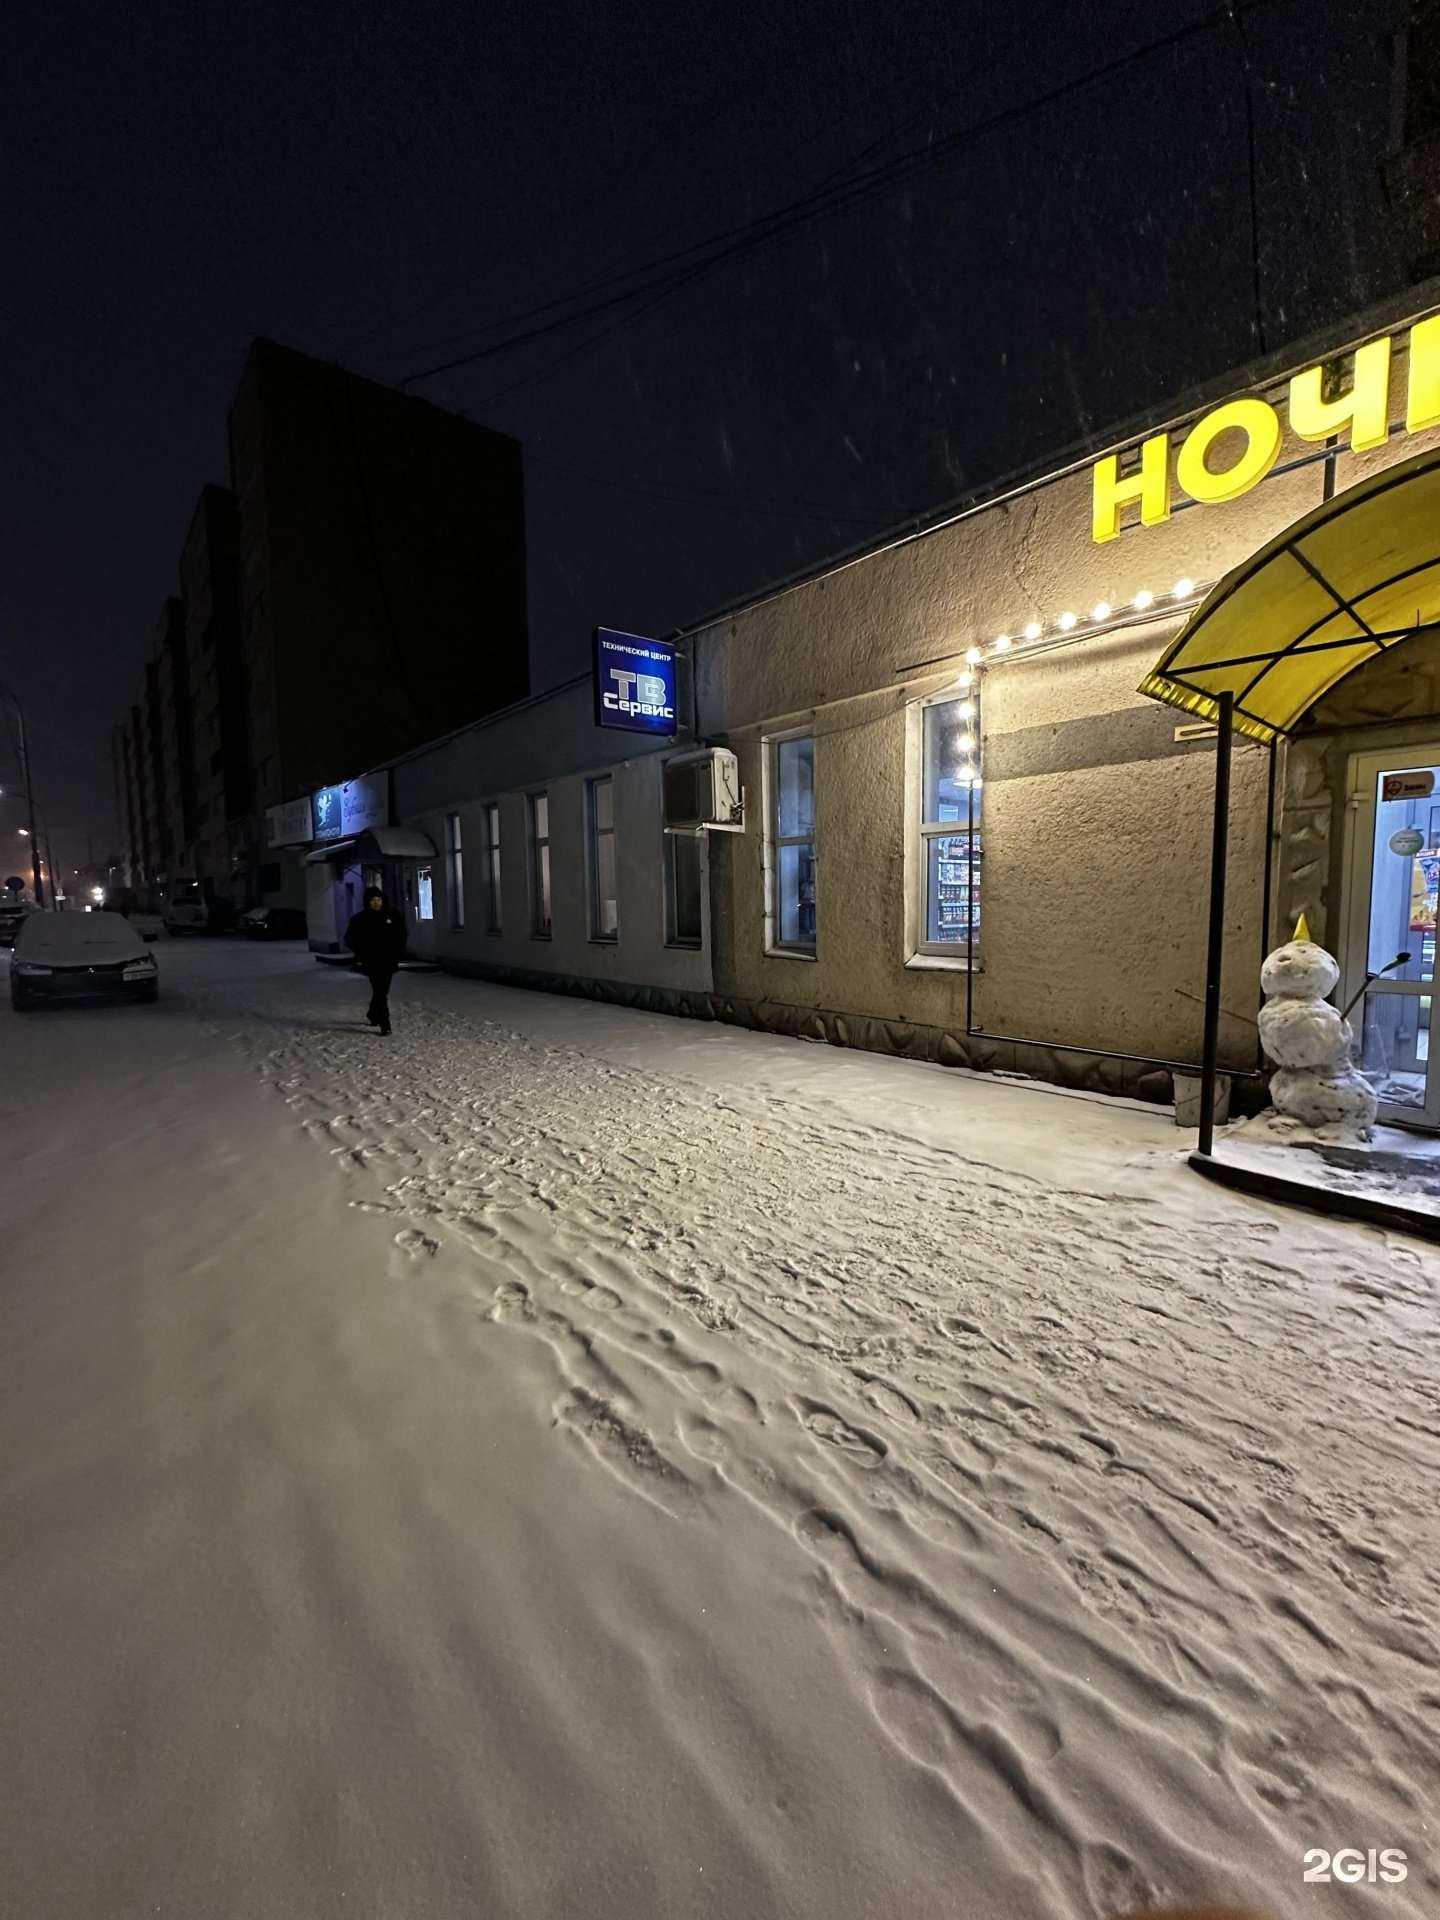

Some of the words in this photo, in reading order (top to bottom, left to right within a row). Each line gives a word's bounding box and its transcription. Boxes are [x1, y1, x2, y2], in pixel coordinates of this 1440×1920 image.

[602, 641, 649, 657] ТЕХНИЧЕСКИЙ
[650, 651, 671, 661] ЦЕНТР
[610, 668, 666, 705] ТВ
[603, 692, 673, 718] Сервис
